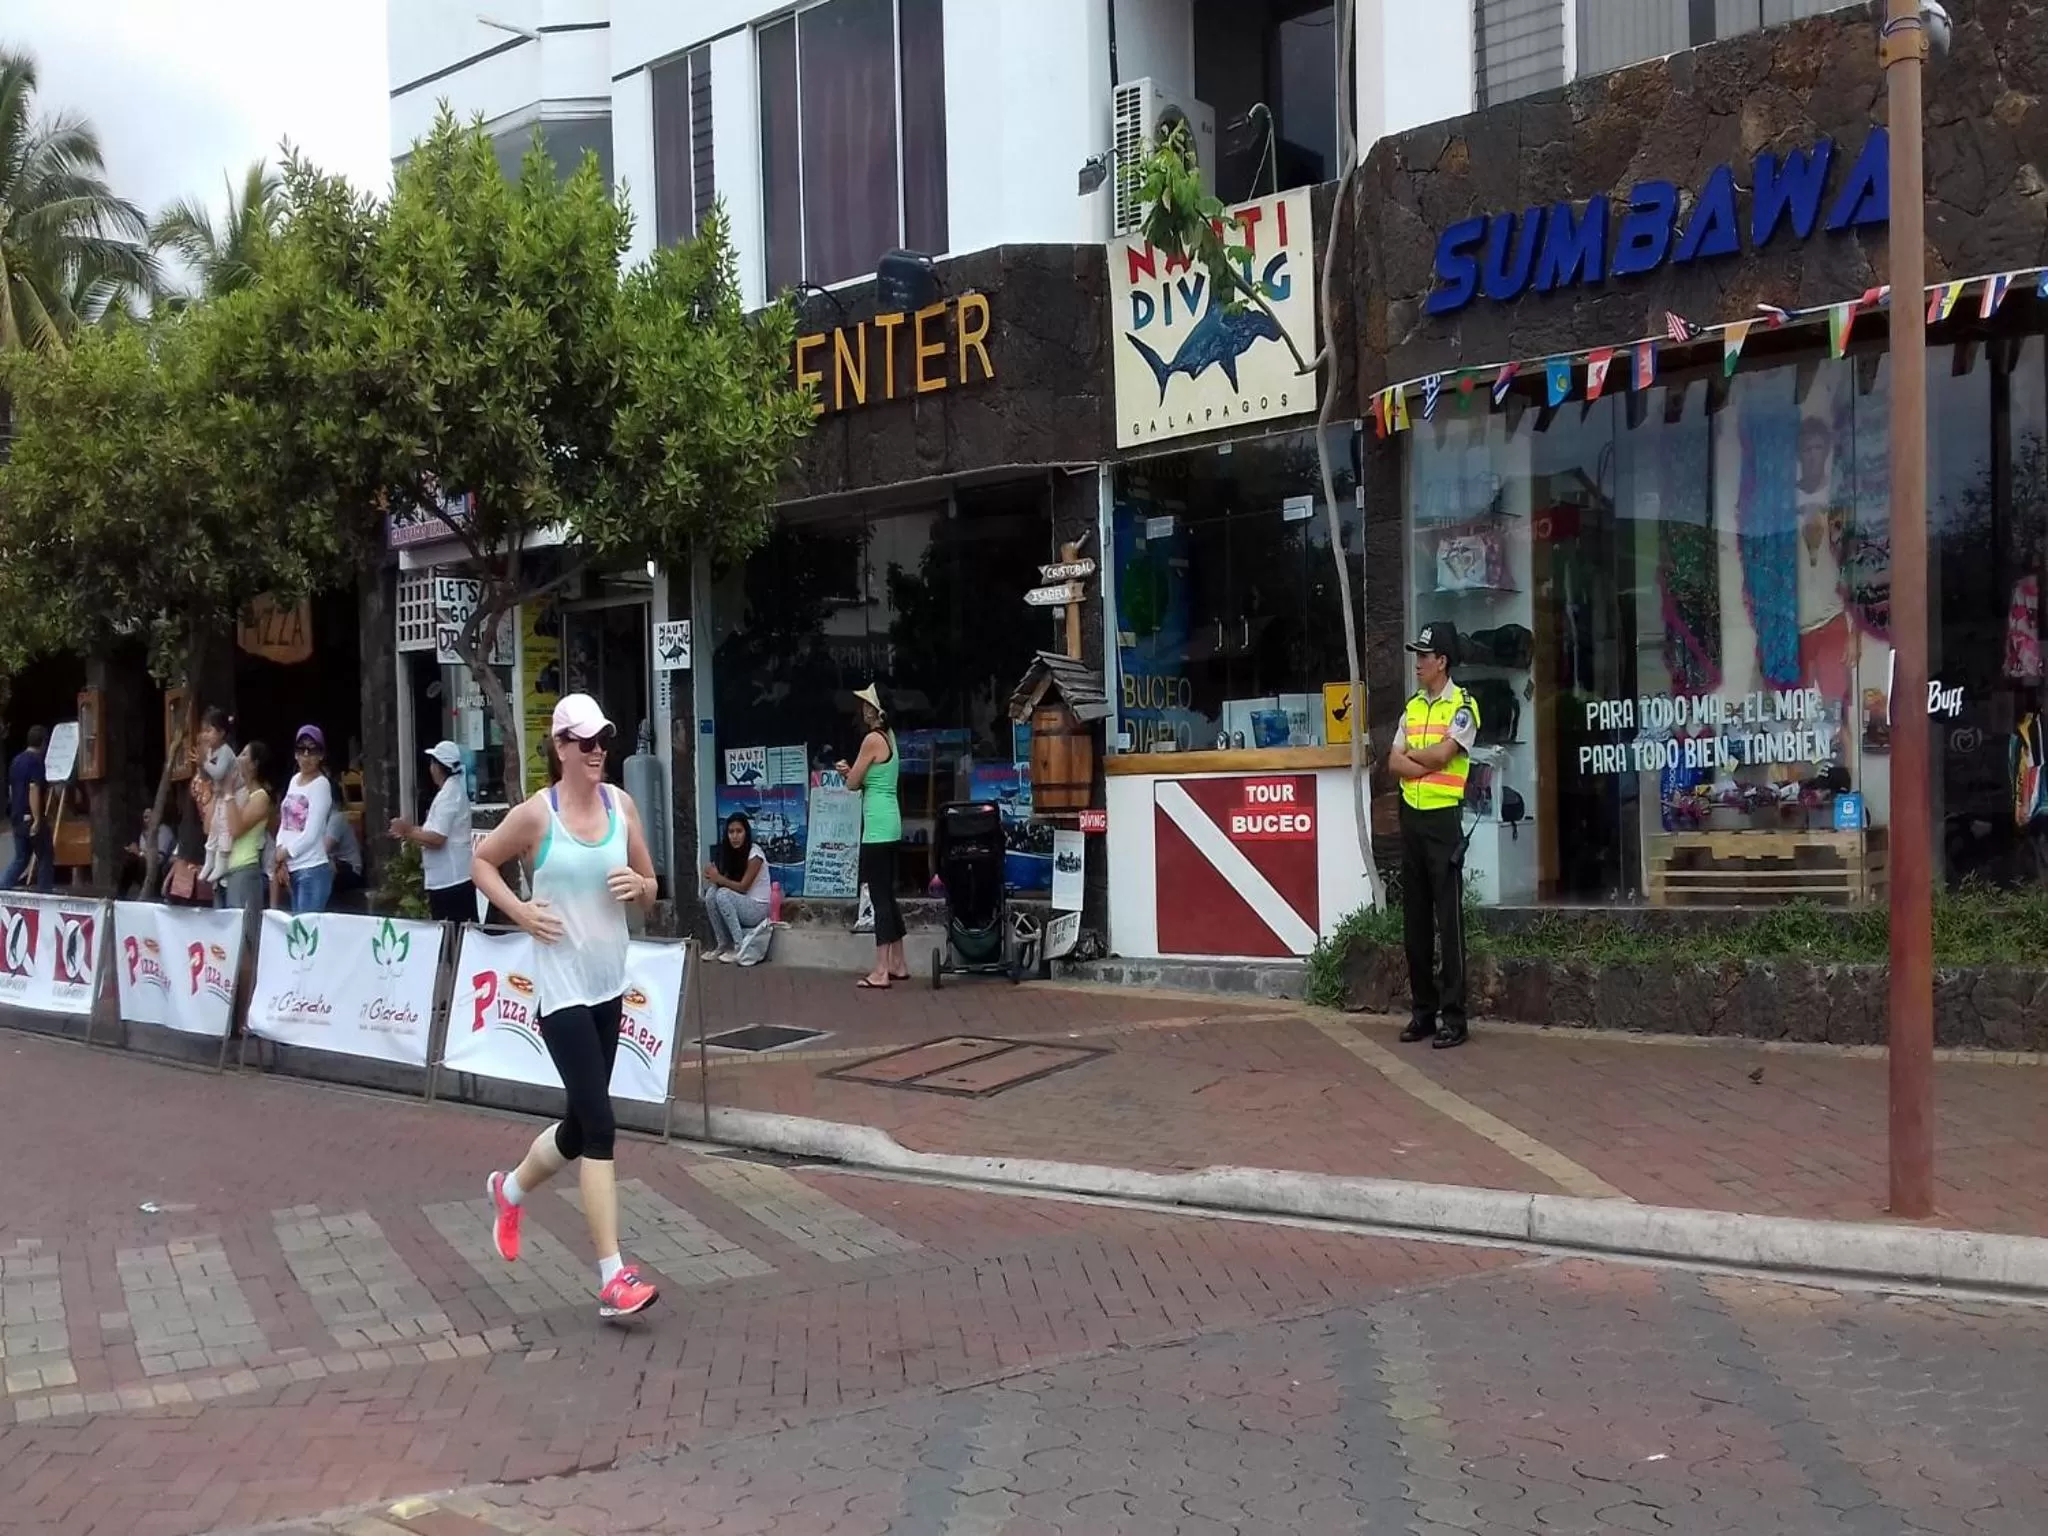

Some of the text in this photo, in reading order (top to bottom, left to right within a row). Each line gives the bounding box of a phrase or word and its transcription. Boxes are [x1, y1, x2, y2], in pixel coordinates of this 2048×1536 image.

[1426, 126, 1889, 315] SUMBAWA
[1130, 251, 1291, 330] DIVG
[1132, 394, 1288, 435] GALAPAGOS
[1046, 561, 1091, 578] CRISTOBAL
[439, 579, 478, 603] LET'S
[450, 605, 469, 623] GO
[658, 624, 689, 636] NAUTI
[1123, 674, 1192, 710] BUCEO
[1926, 680, 1965, 717] Buff
[1586, 698, 1634, 731] PARA
[1638, 695, 1687, 729] TODO
[1744, 691, 1770, 723] EL
[729, 749, 764, 761] NAUTI
[730, 760, 764, 772] DIVING
[1579, 743, 1627, 775] PARA
[1631, 738, 1679, 771] TODO
[1245, 784, 1295, 803] TOUR
[1080, 814, 1106, 828] DIVING
[1232, 814, 1312, 834] BUCEO
